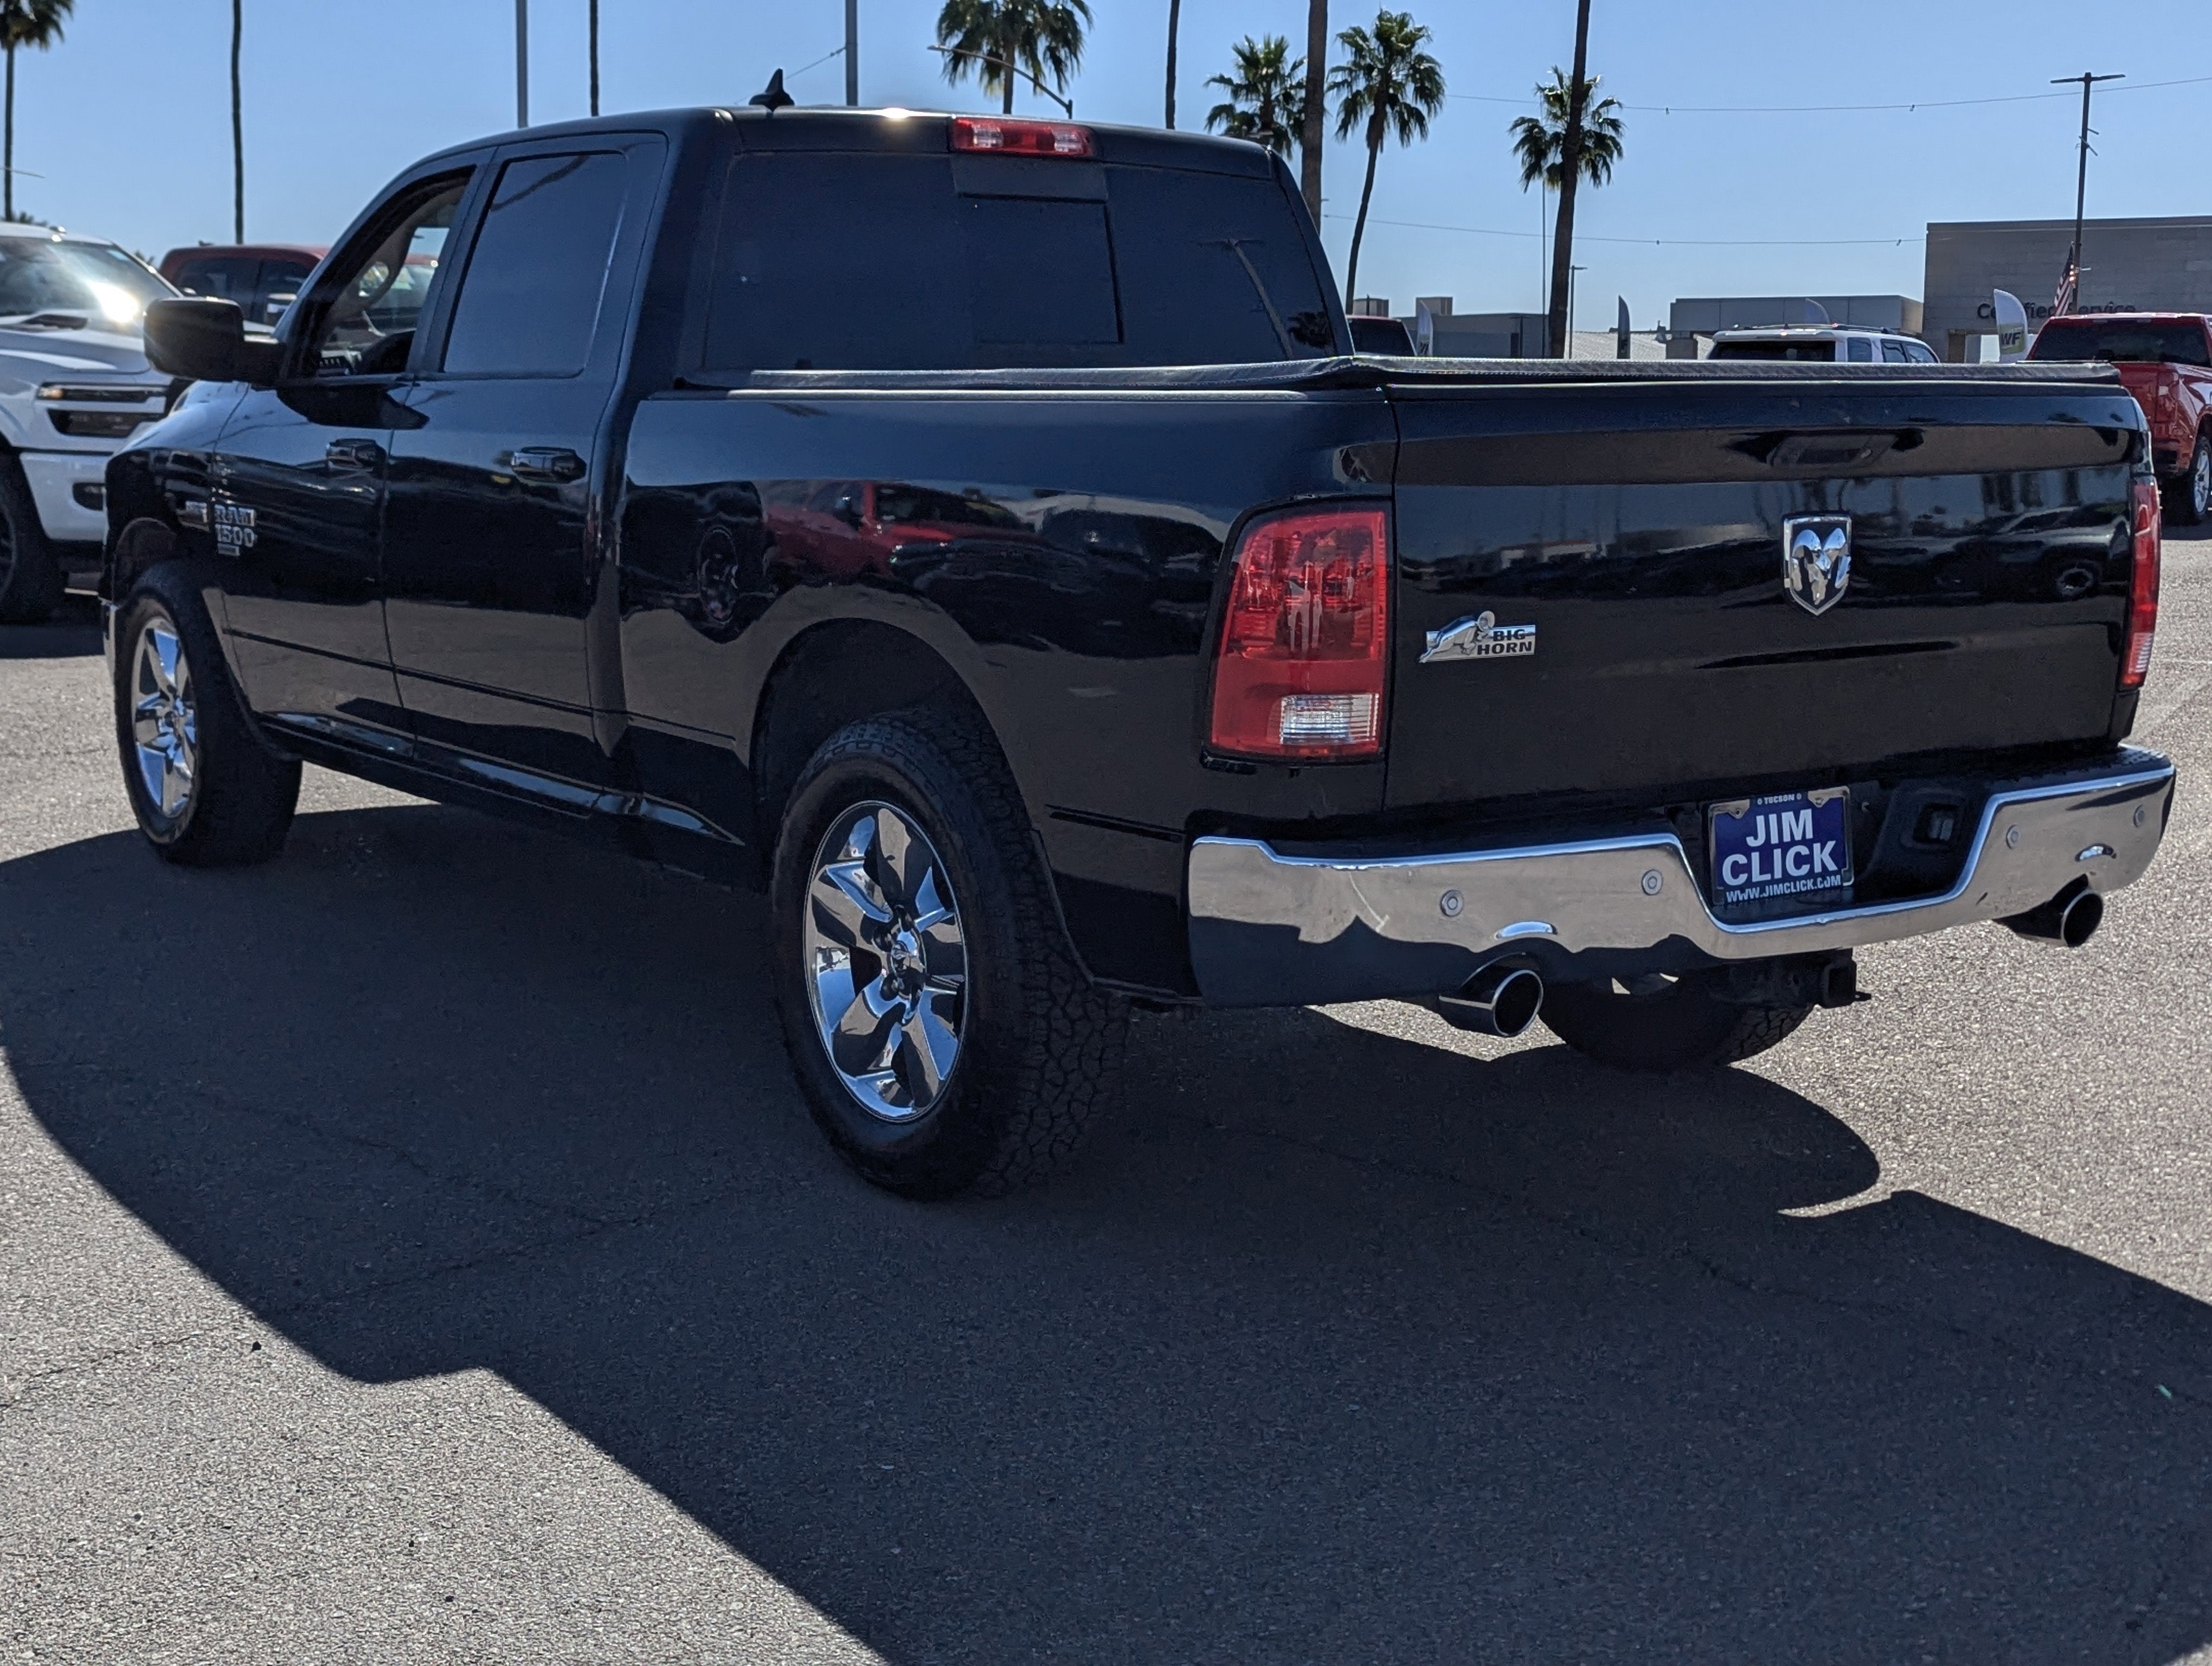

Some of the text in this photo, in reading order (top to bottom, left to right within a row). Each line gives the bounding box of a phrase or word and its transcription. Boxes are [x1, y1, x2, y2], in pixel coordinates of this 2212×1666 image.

[1977, 302, 2055, 319] Cefie
[215, 523, 255, 548] 1500
[1493, 629, 1526, 642] BIG
[1477, 642, 1532, 655] HORN
[1745, 808, 1814, 848] JIM
[1722, 840, 1838, 886] CLICK
[1726, 874, 1841, 903] WWW.JIMCLICK.COM
